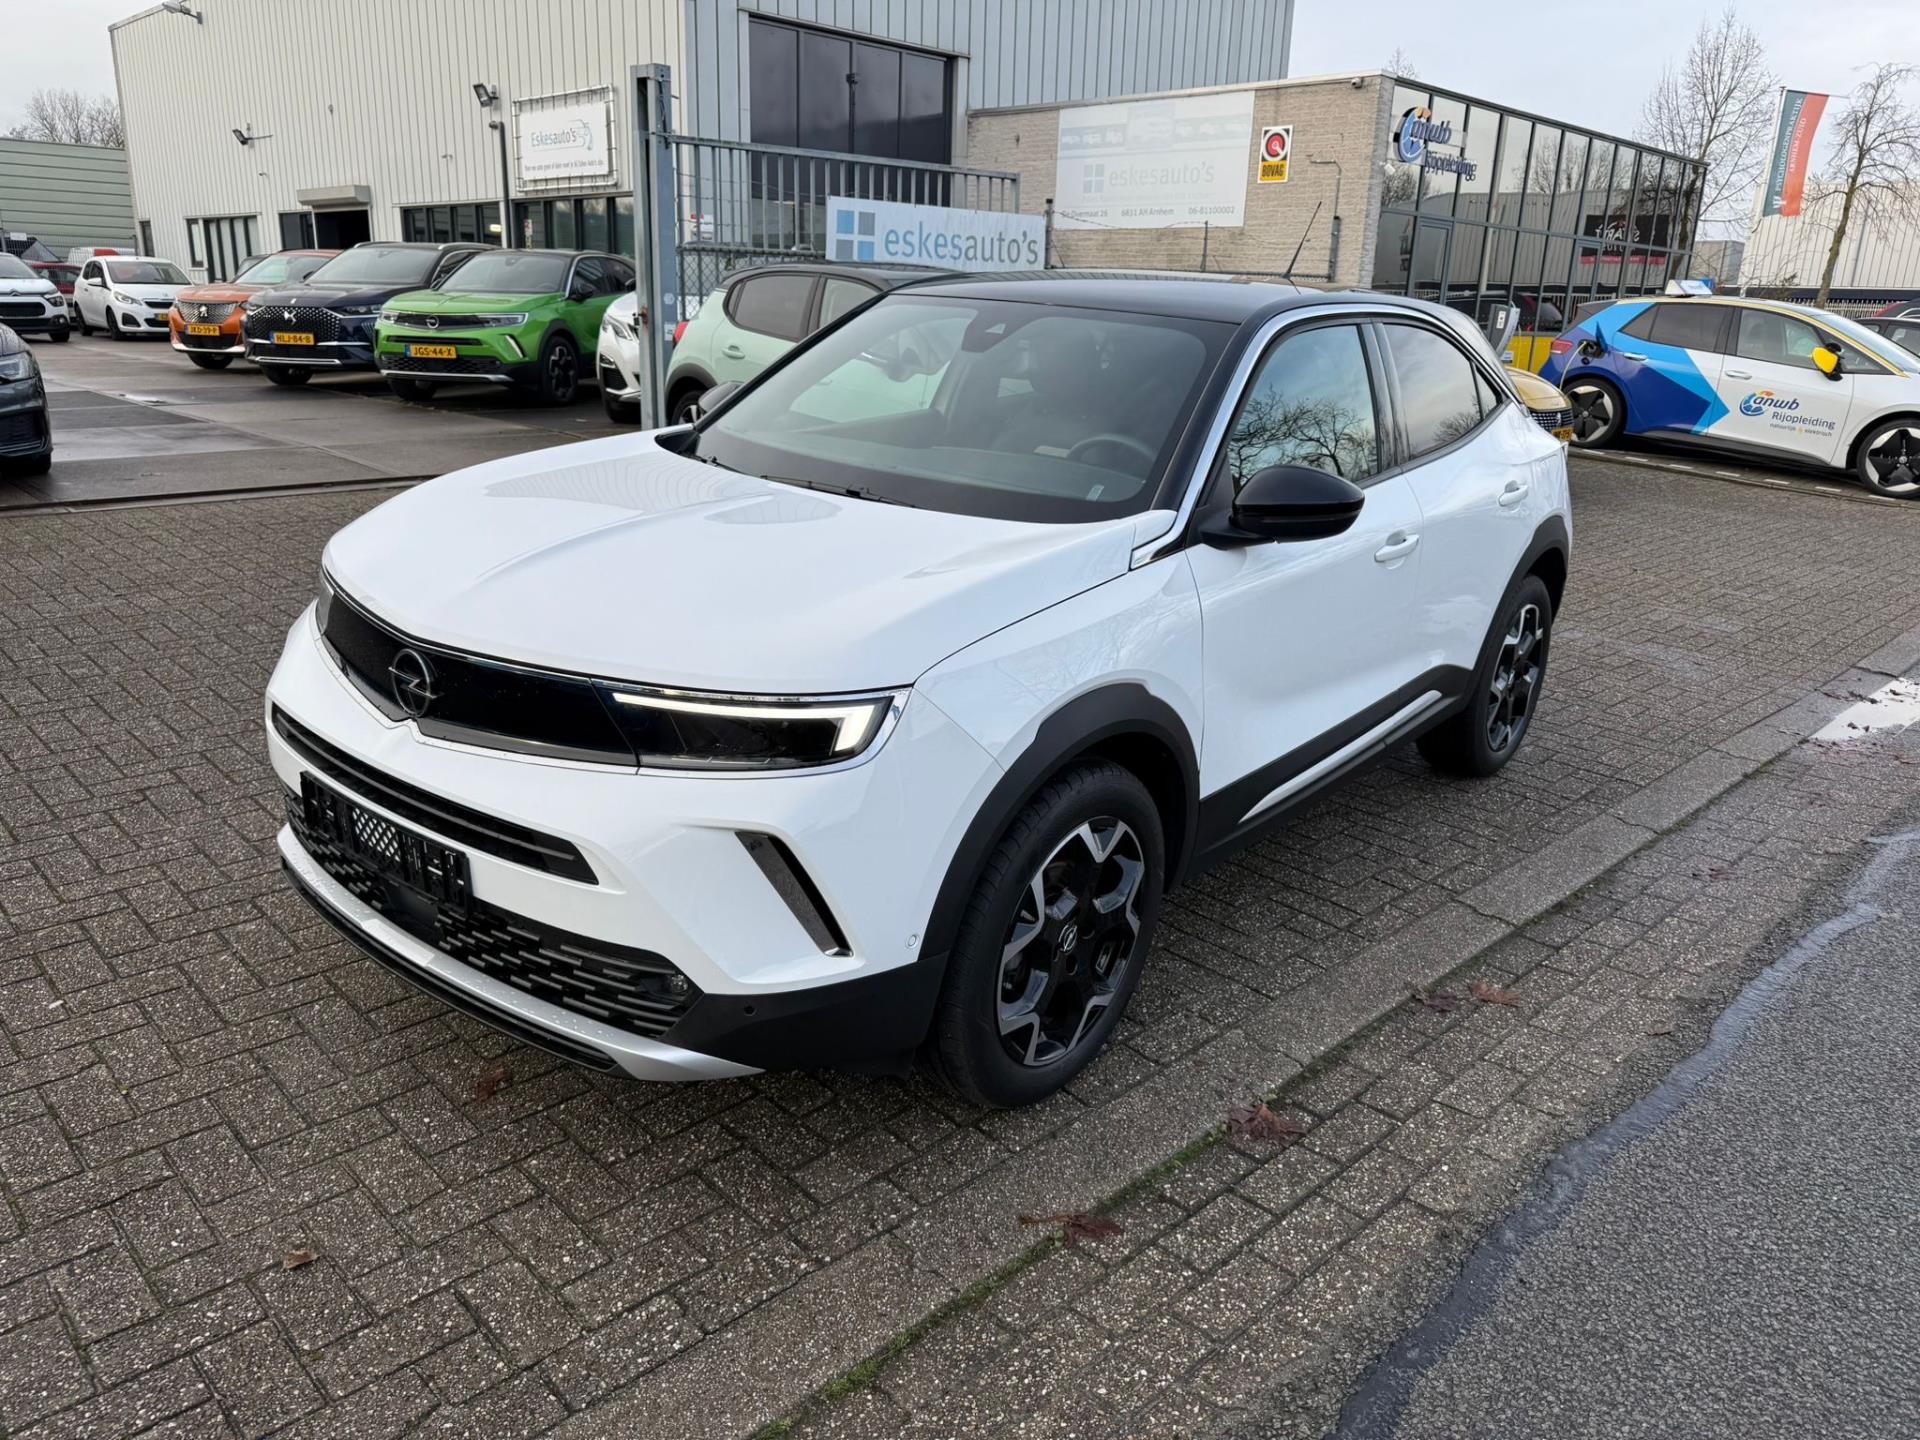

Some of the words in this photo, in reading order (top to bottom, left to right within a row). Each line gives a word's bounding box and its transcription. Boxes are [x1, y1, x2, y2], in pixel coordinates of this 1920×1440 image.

[1109, 162, 1215, 186] eskesauto's
[1261, 163, 1285, 178] BOVAG
[884, 220, 1039, 265] eskesauto's
[1753, 396, 1800, 411] anwb
[1771, 411, 1836, 430] Rijopleiding
